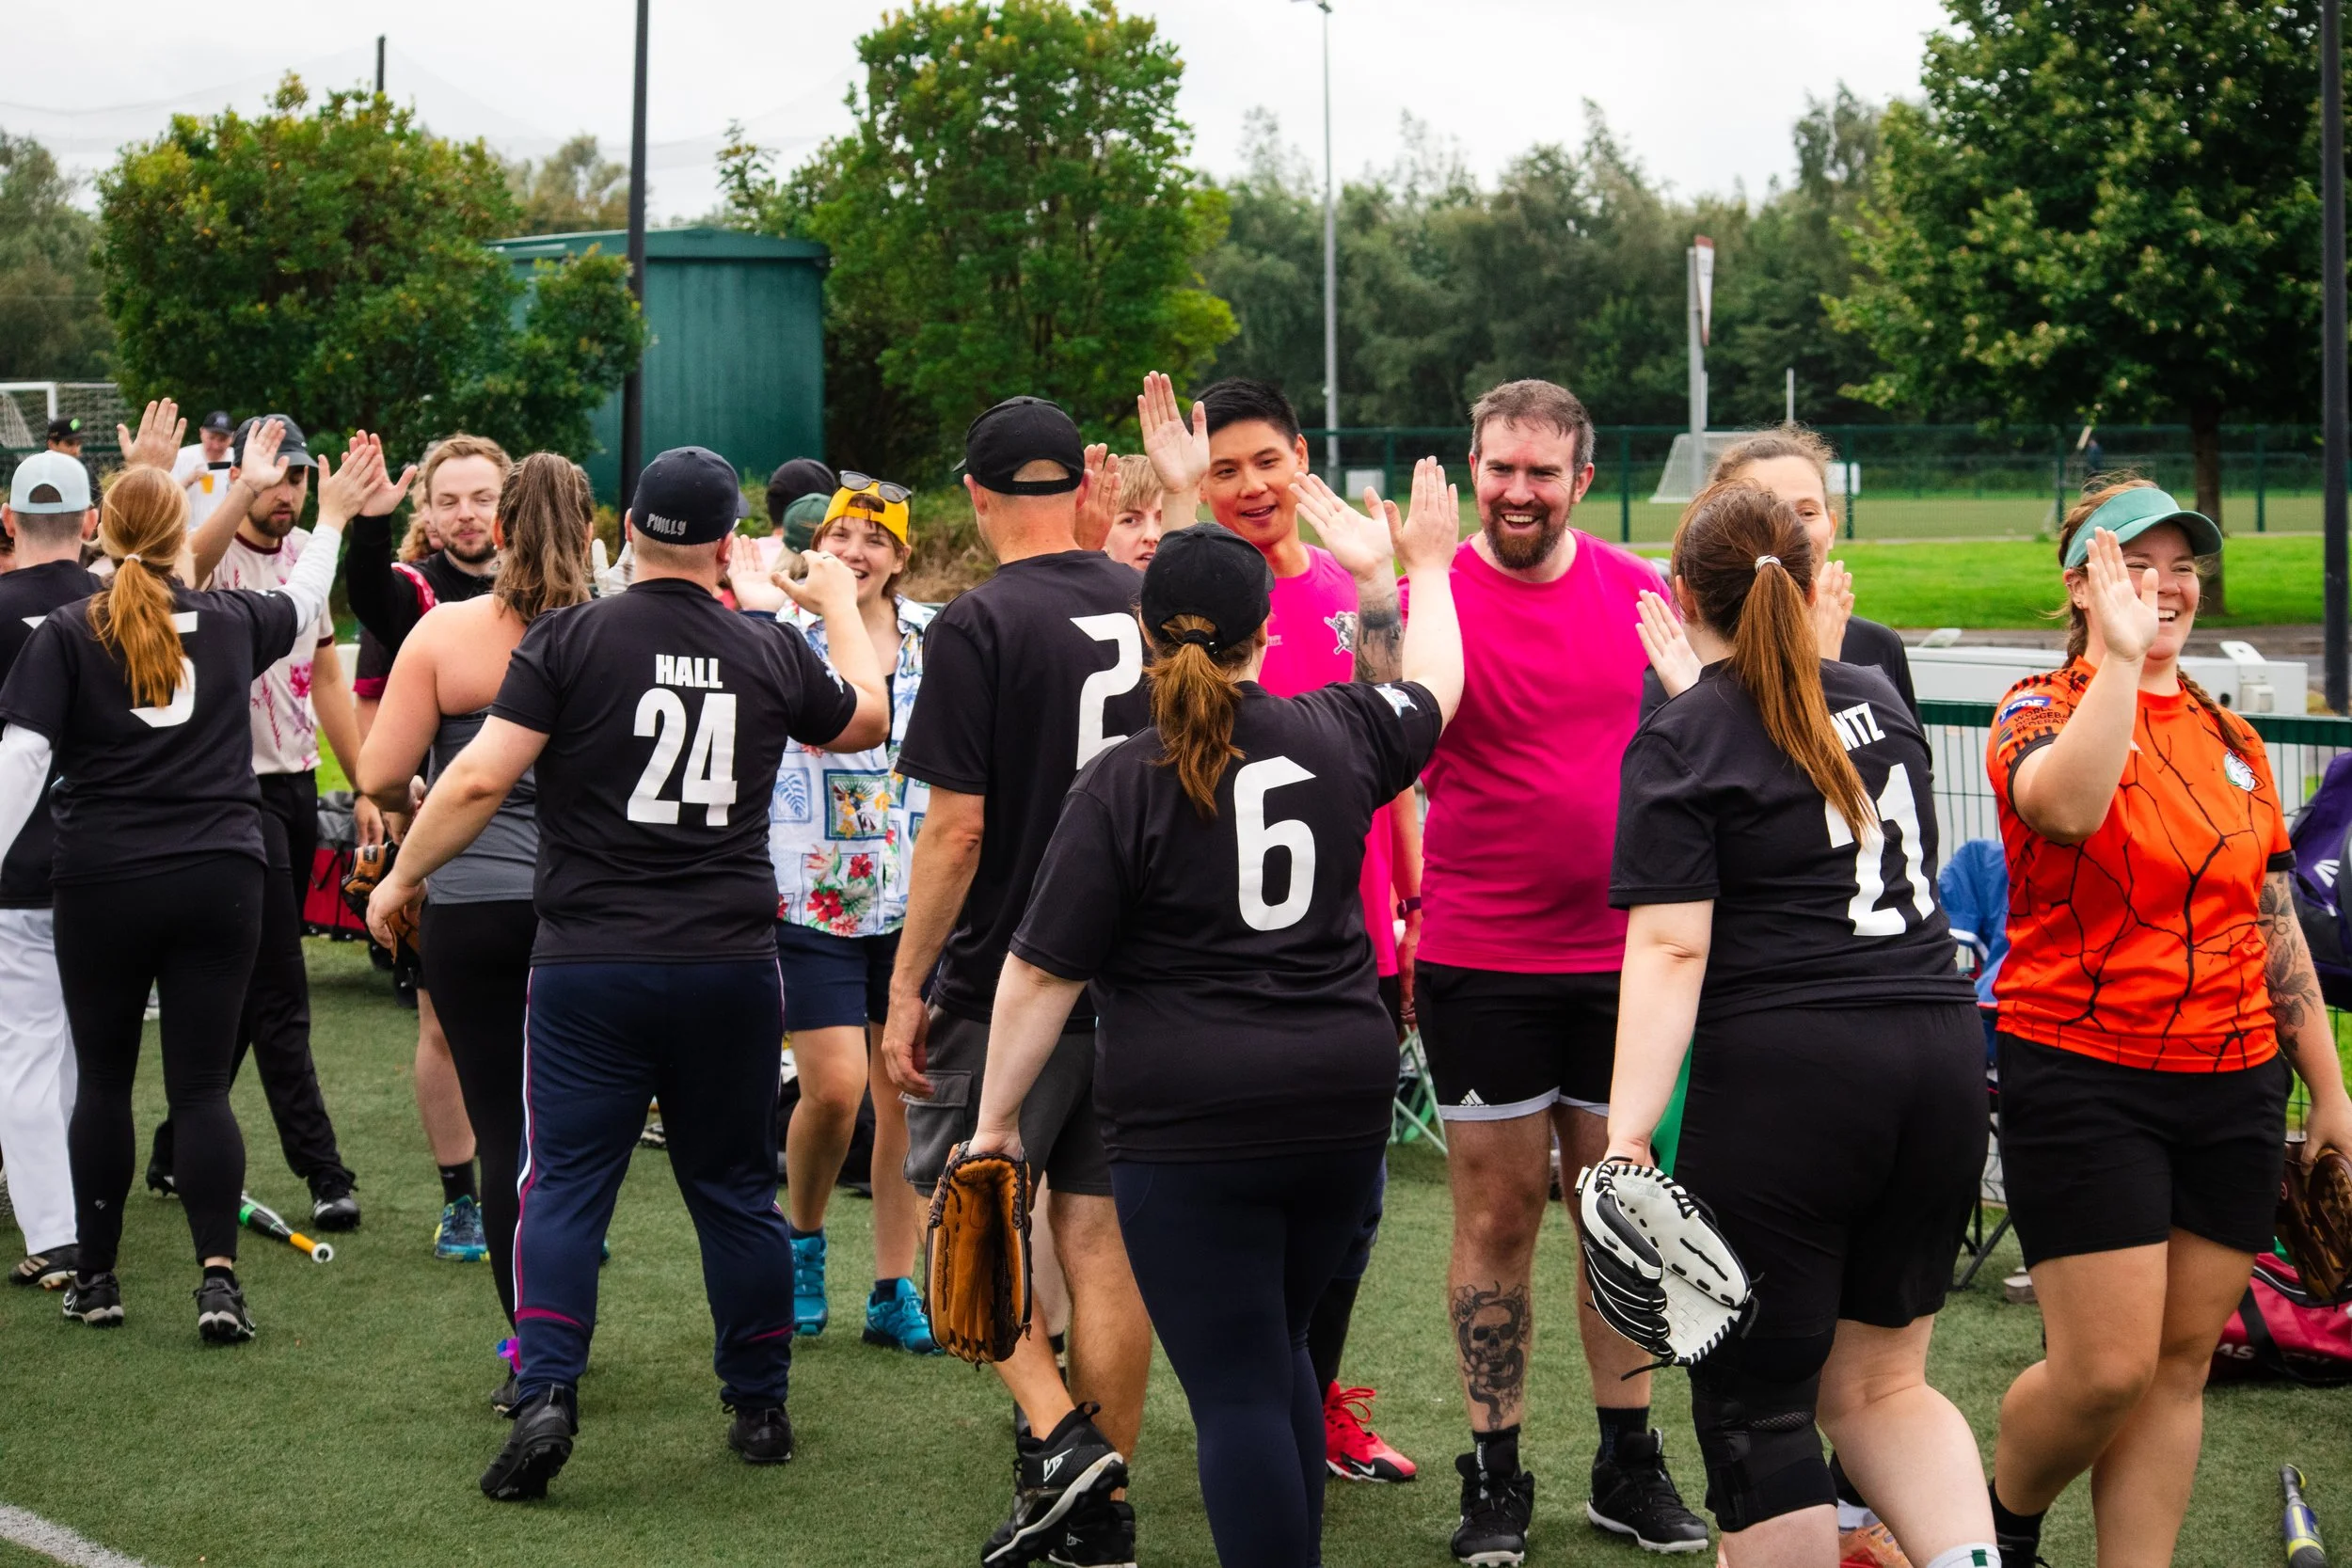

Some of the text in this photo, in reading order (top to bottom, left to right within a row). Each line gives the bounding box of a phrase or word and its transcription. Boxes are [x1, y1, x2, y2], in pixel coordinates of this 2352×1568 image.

[646, 513, 687, 536] PHILLY
[655, 654, 723, 689] HALL
[1830, 702, 1886, 752] NTZ
[2016, 719, 2068, 734] FEDERAT
[628, 688, 738, 827] 24
[1233, 755, 1317, 931] 6
[1825, 763, 1935, 936] 21
